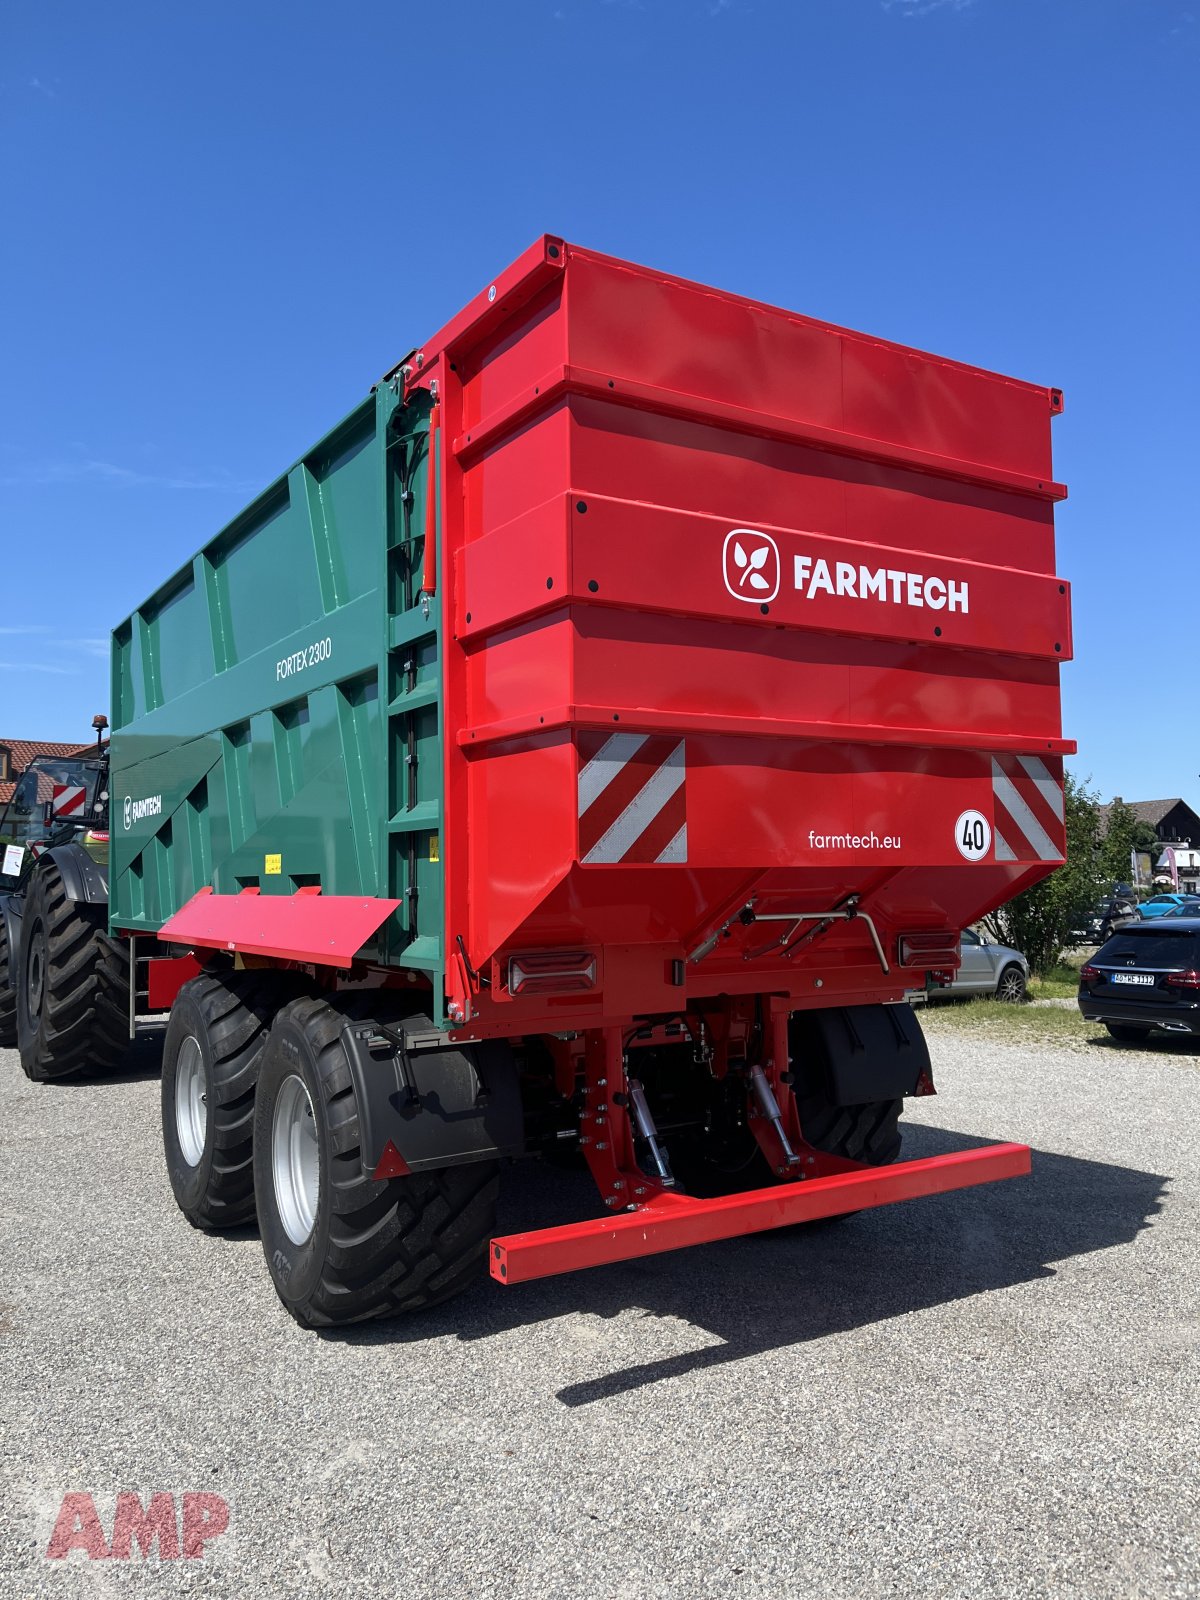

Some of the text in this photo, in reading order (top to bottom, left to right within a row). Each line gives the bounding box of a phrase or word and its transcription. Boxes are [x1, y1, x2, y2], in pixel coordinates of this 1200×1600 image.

[794, 554, 968, 613] FARMTECH
[276, 637, 332, 681] FORTEX 2300
[132, 794, 161, 823] FARMTECH
[808, 830, 901, 849] farmtech.eu
[962, 819, 985, 851] 40
